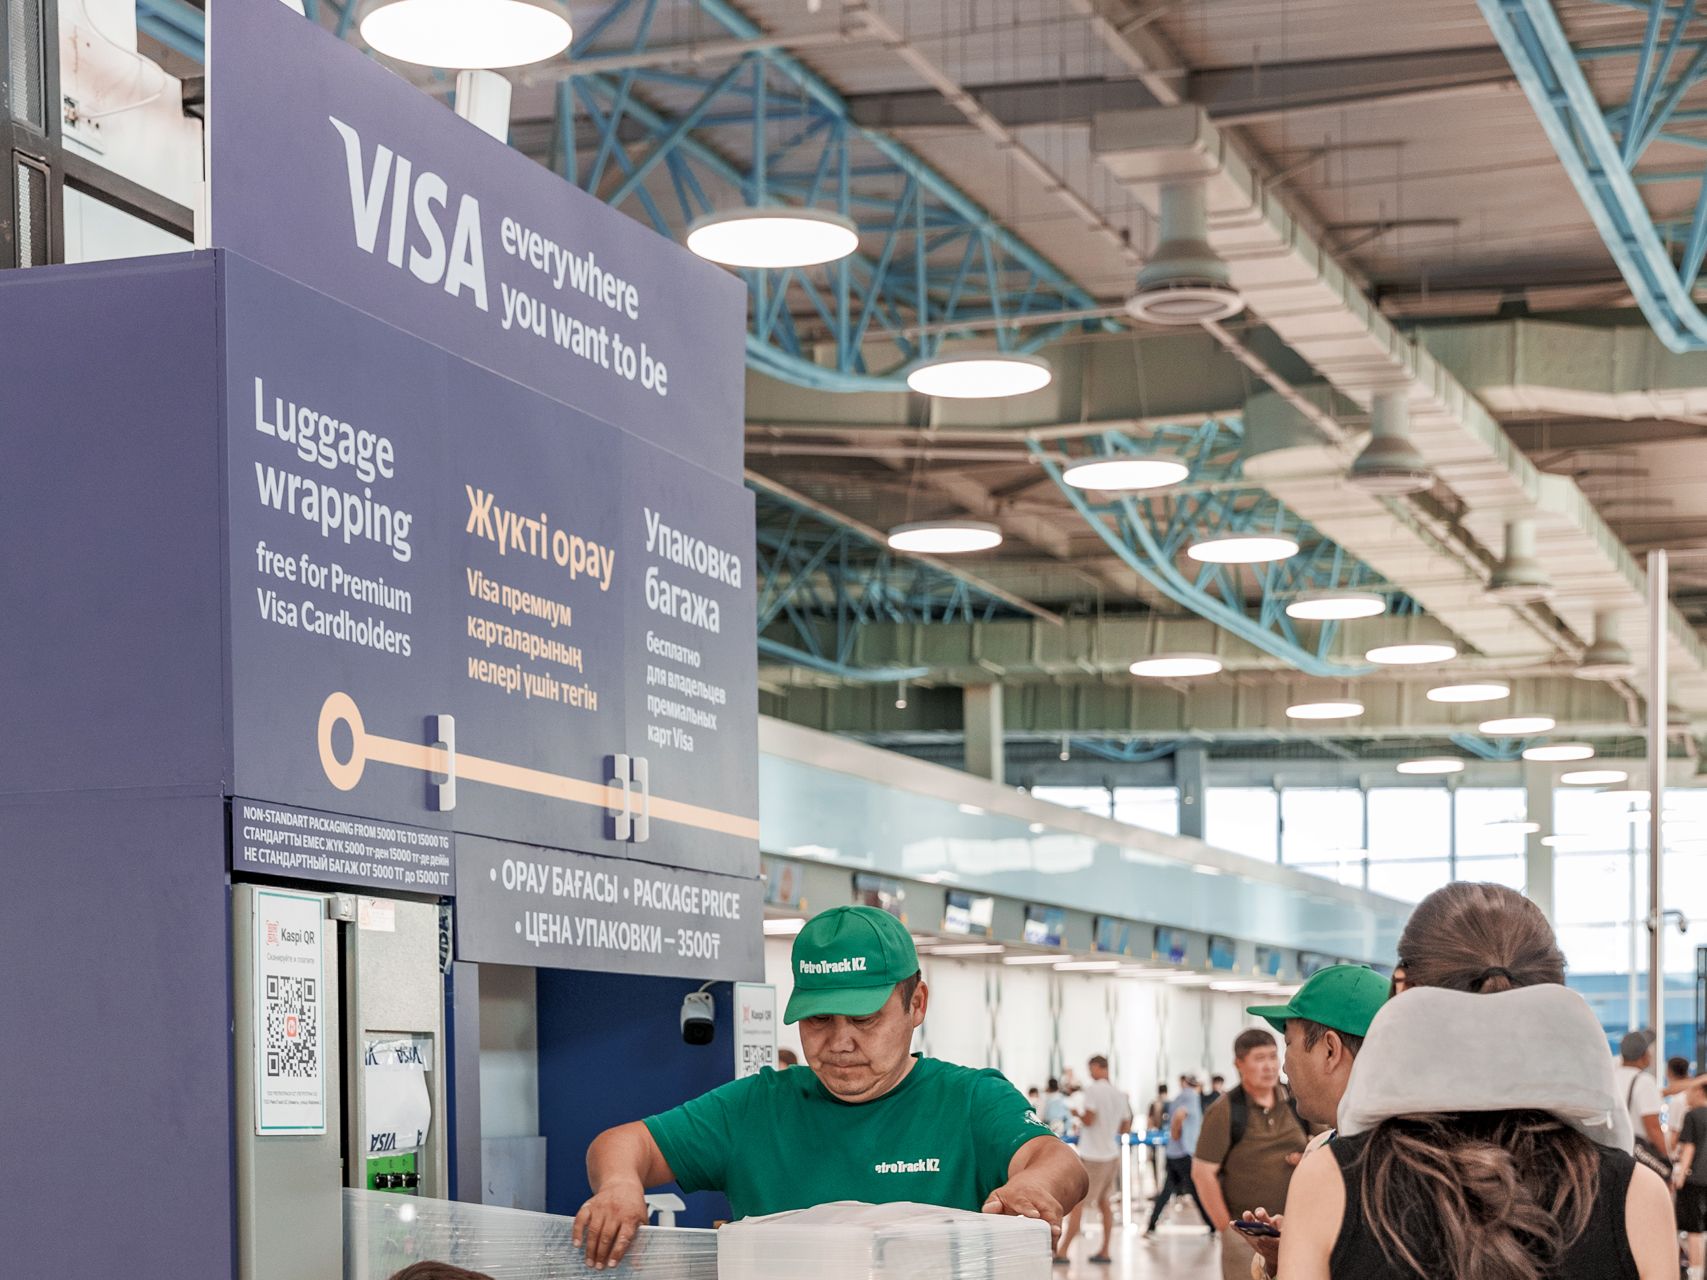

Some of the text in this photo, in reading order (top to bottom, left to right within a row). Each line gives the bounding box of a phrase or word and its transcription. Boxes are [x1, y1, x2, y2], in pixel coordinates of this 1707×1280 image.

[329, 115, 488, 312] VISA
[501, 216, 639, 320] everywhere
[501, 281, 667, 396] you want to be
[254, 377, 394, 483] Luggage
[255, 462, 412, 562] wrapping
[465, 484, 615, 591] Жүкті орау
[643, 507, 742, 588] Упаковка
[256, 541, 412, 615] free for Premium
[466, 567, 572, 628] Visa премиум
[645, 567, 720, 633] багажа
[257, 588, 412, 656] Visa Cardholders
[467, 615, 583, 674] карталарының
[646, 630, 701, 668] бесплатно
[467, 656, 598, 712] иелері үшін тегін
[646, 664, 727, 705] для владельцев
[647, 694, 717, 731] премиальных
[647, 723, 694, 752] карт Visa
[243, 805, 449, 849] NON-STANDART PACKAGING FROM 5000 TG TO 15000 TG
[243, 826, 302, 848] СТАНДАРТТЫ
[303, 837, 325, 851] ЕМЕС
[344, 841, 365, 856] 5000
[389, 848, 411, 863] 15000
[244, 846, 450, 886] НЕ СТАНДАРТНЫЙ БАГАЖ ОТ 5000 ТГ до 15000 ТГ
[501, 859, 618, 904] ОРАУ БАҒАСЫ
[633, 878, 740, 920] PACKAGE PRICE
[281, 928, 315, 946] Kaspi QR
[525, 911, 573, 947] ЦЕНА
[574, 916, 662, 954] УПАКОВКИ
[799, 956, 867, 974] PetroTrack KZ
[370, 1132, 397, 1152] VISA
[926, 1158, 940, 1172] KZ
